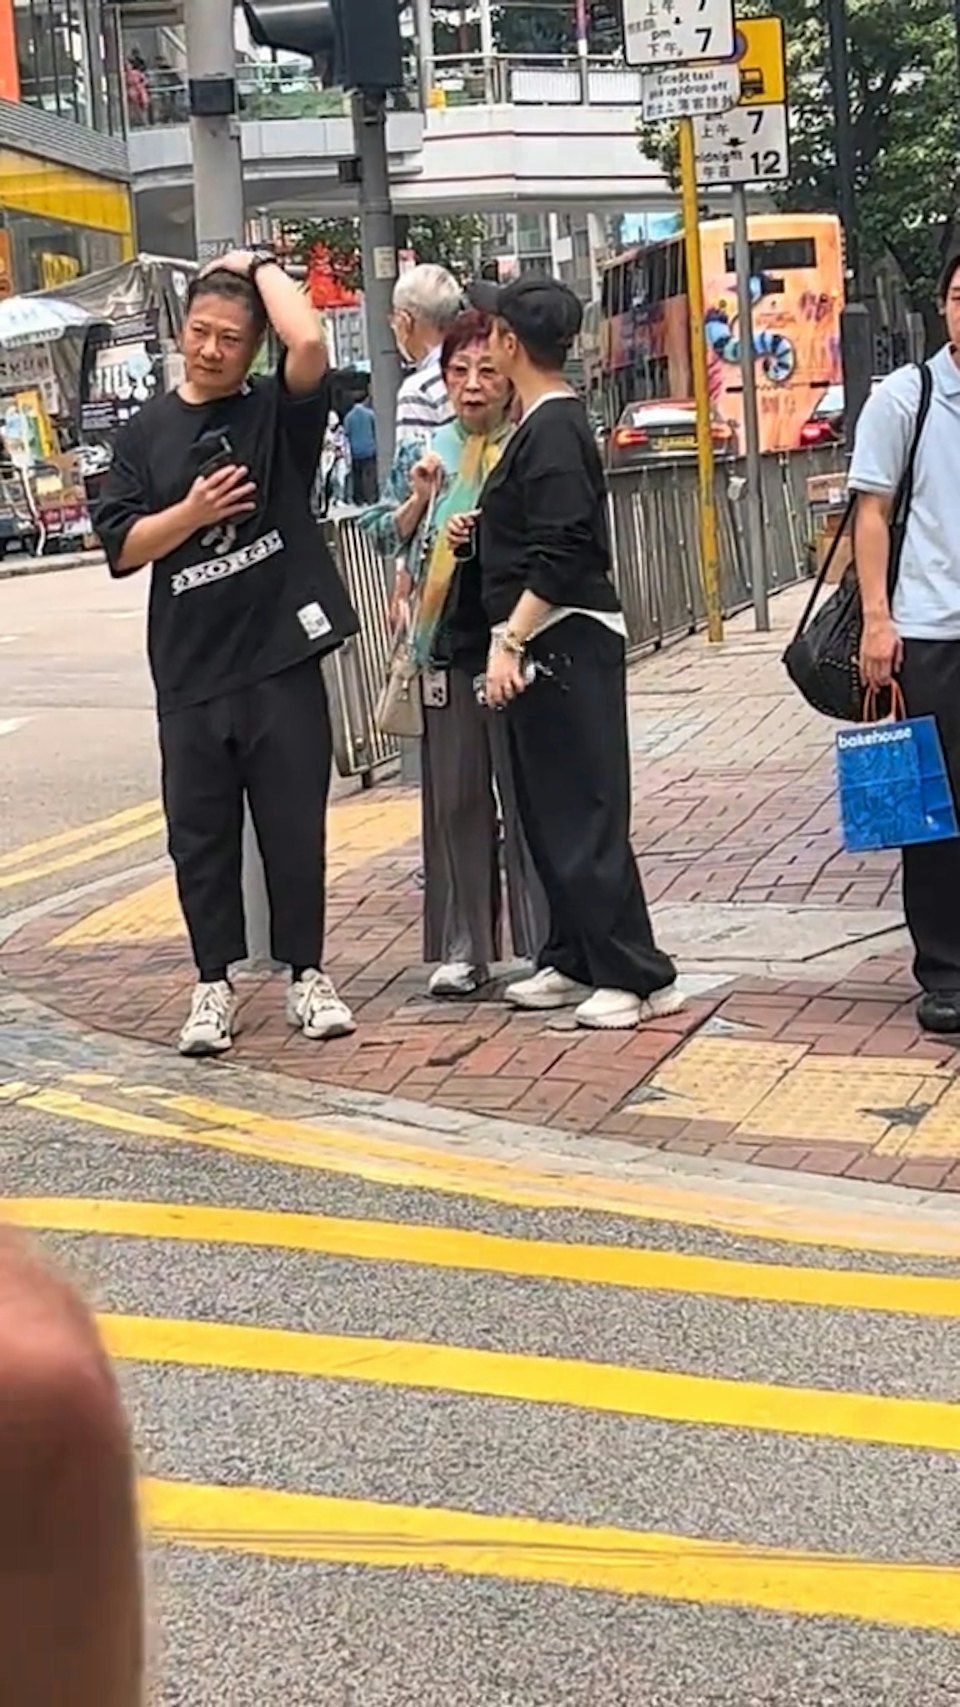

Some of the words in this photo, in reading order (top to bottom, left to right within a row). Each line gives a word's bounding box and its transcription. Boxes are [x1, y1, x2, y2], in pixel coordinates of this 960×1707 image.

[651, 29, 671, 41] pm
[695, 27, 712, 53] 7
[701, 124, 729, 138] 上午
[747, 110, 763, 134] 7
[750, 150, 780, 175] 12
[838, 727, 912, 748] bakehouse
